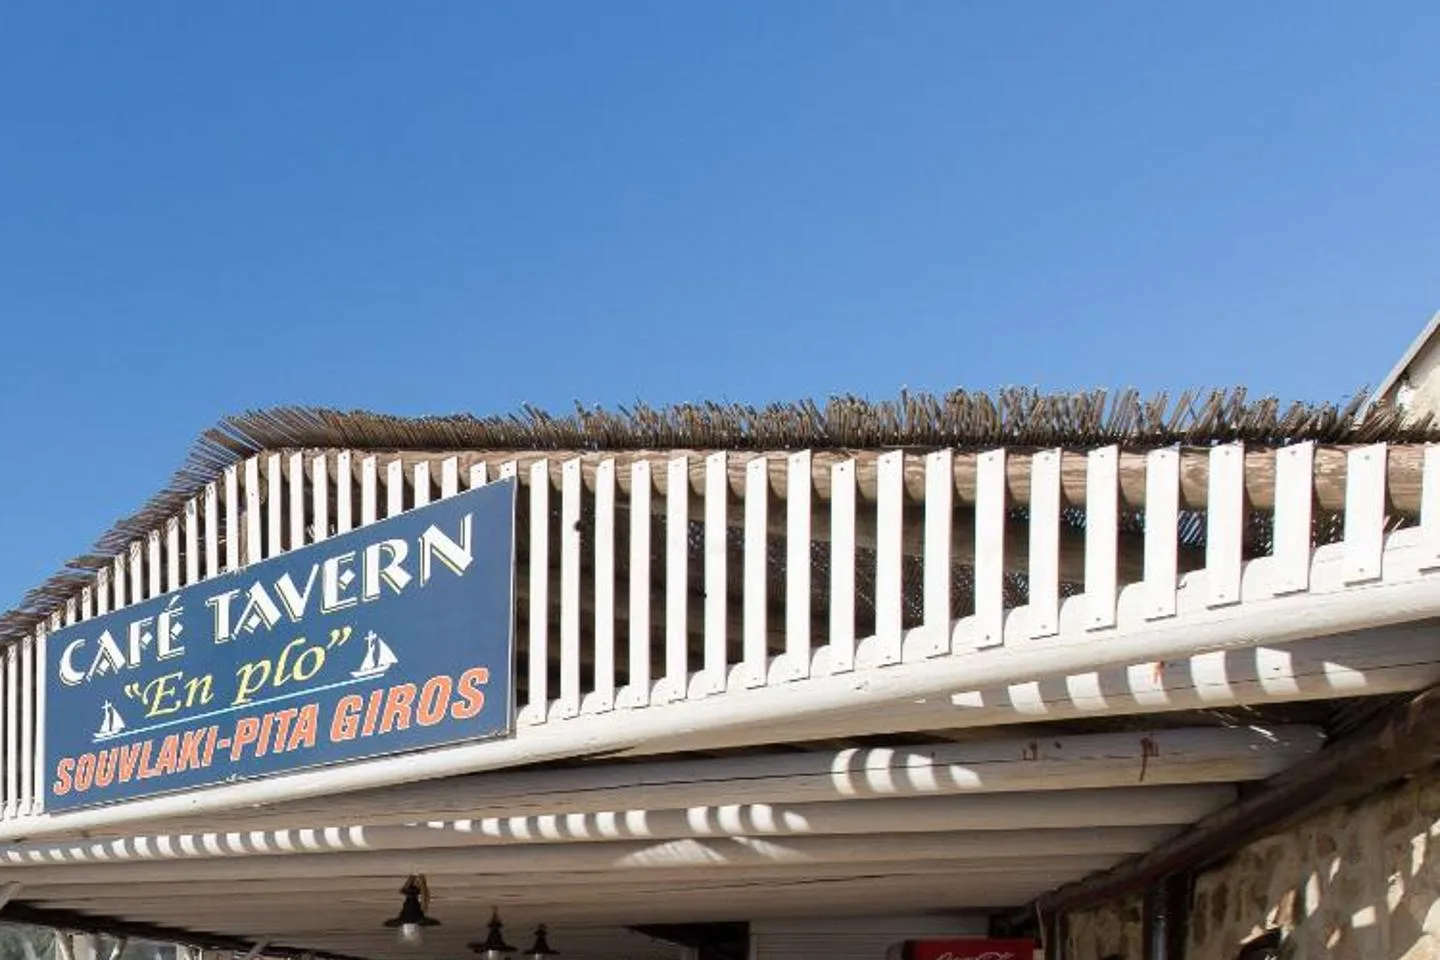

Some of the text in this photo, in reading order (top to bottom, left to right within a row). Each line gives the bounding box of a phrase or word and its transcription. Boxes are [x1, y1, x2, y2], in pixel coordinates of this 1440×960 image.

[59, 514, 474, 687] CAFÉ TAVERN
[53, 666, 490, 796] SOUVLAKI-PITA GIROS
